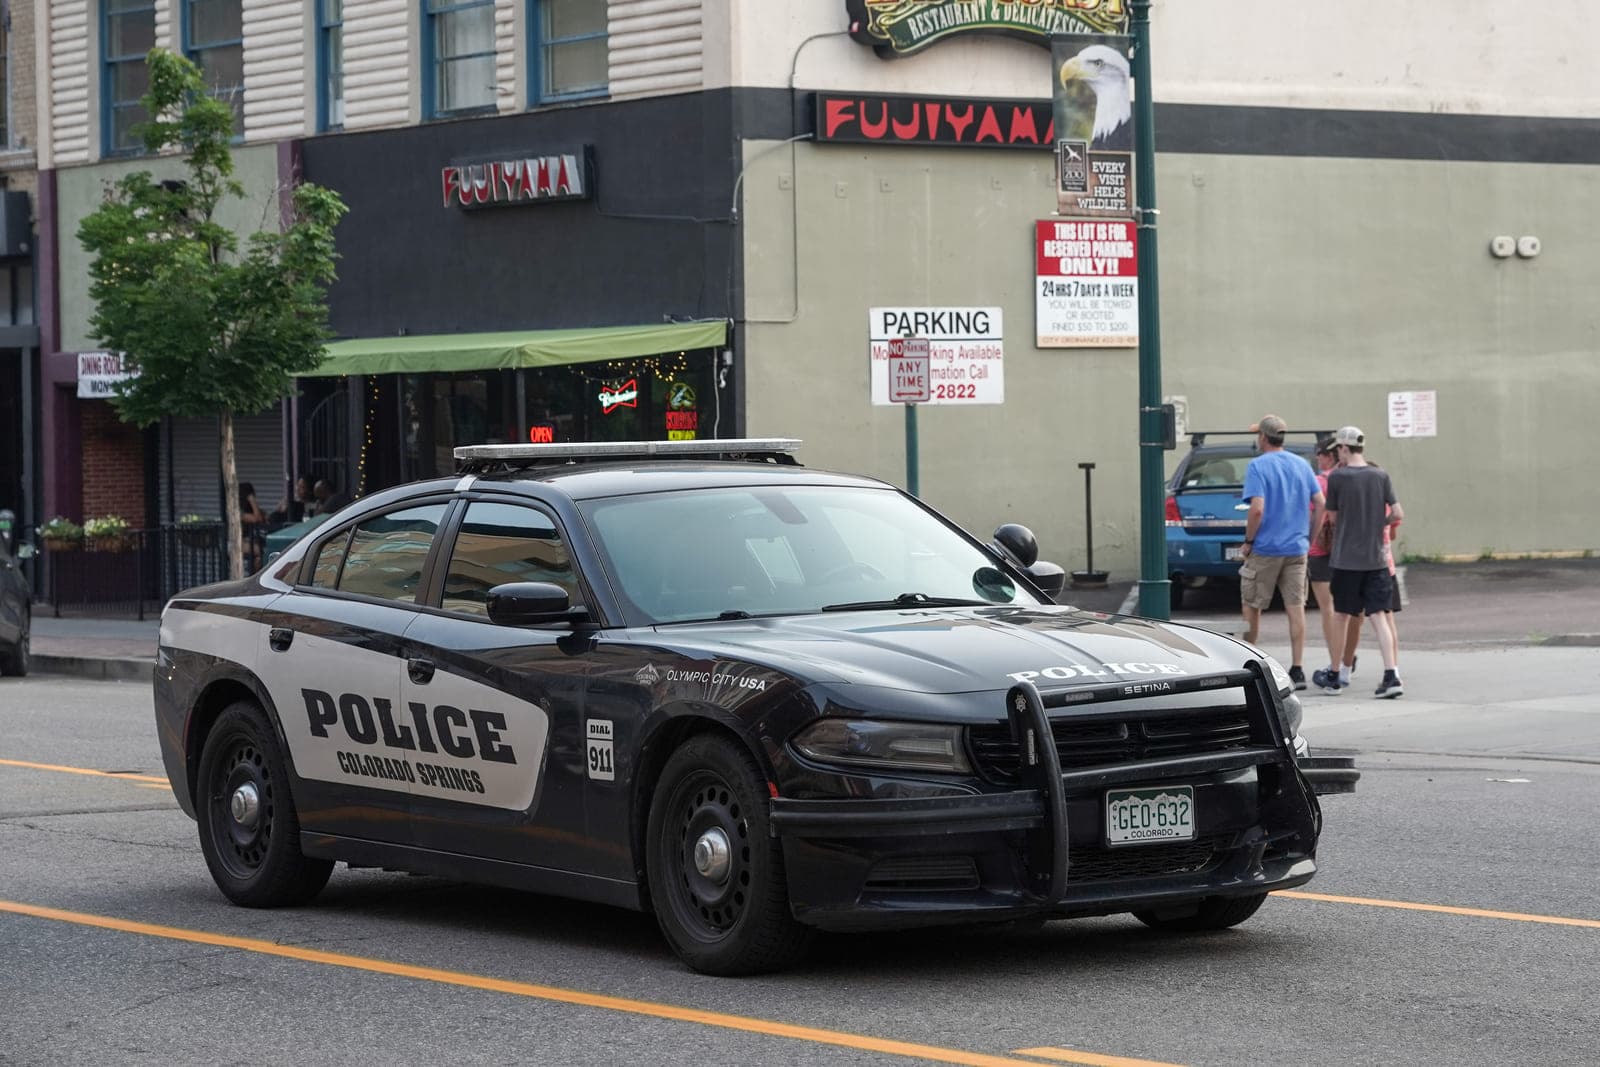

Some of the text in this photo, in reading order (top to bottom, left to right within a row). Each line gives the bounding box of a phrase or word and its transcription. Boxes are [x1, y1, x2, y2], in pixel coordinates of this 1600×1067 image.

[907, 1, 986, 40] RESTAURANT
[991, 0, 1000, 20] &
[1092, 161, 1126, 174] EVERY
[442, 155, 583, 208] FUJIYAMA
[1098, 174, 1126, 186] VISIT
[1094, 186, 1126, 198] HELPS
[1077, 198, 1127, 210] WILDLIFE
[1054, 222, 1127, 240] THIS LOT IS FOR
[1044, 240, 1134, 258] RESERVED PARKING
[1060, 258, 1119, 275] ONLY!!
[1112, 284, 1134, 297] WEEK
[1048, 300, 1132, 310] YOU WILL BE TOWED
[883, 311, 990, 335] PARKING
[1066, 311, 1077, 321] OR
[873, 344, 1001, 363] Mo rking Available
[890, 341, 903, 356] NO
[898, 361, 922, 374] ANY
[930, 364, 988, 380] mation Call
[896, 375, 924, 388] TIME
[931, 383, 976, 399] -2822
[530, 427, 553, 443] OPEN
[666, 669, 709, 683] OLYMPIC
[712, 673, 738, 686] CITY
[739, 678, 767, 691] USA
[1006, 662, 1187, 684] POLICE
[1124, 682, 1171, 696] SETINA
[301, 688, 517, 765] POLICE
[590, 724, 611, 735] DIAL
[589, 746, 613, 773] 911
[336, 750, 486, 794] COLORADO SPRINGS
[1131, 828, 1174, 839] COLORADO
